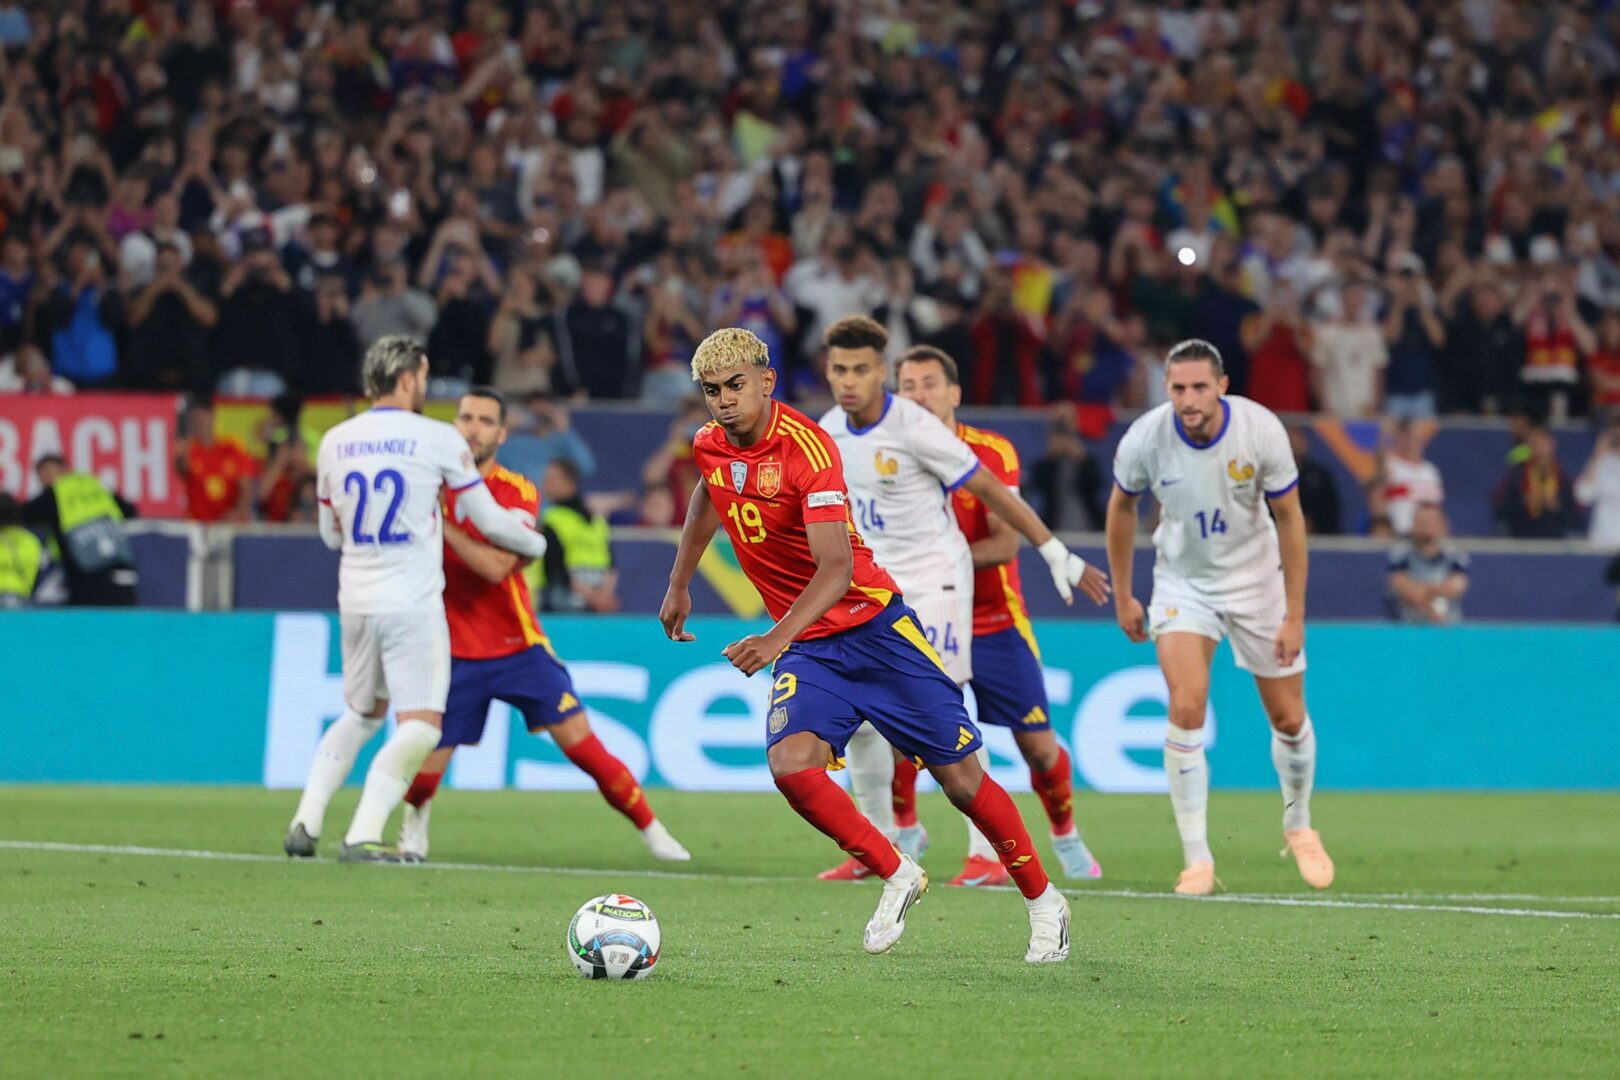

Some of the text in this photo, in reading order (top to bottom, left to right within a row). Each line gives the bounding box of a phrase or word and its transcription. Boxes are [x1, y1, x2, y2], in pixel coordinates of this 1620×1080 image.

[343, 469, 411, 544] 22
[727, 501, 767, 544] 19
[857, 498, 885, 531] 24
[1194, 508, 1228, 539] 14
[263, 612, 1217, 793] Hsese
